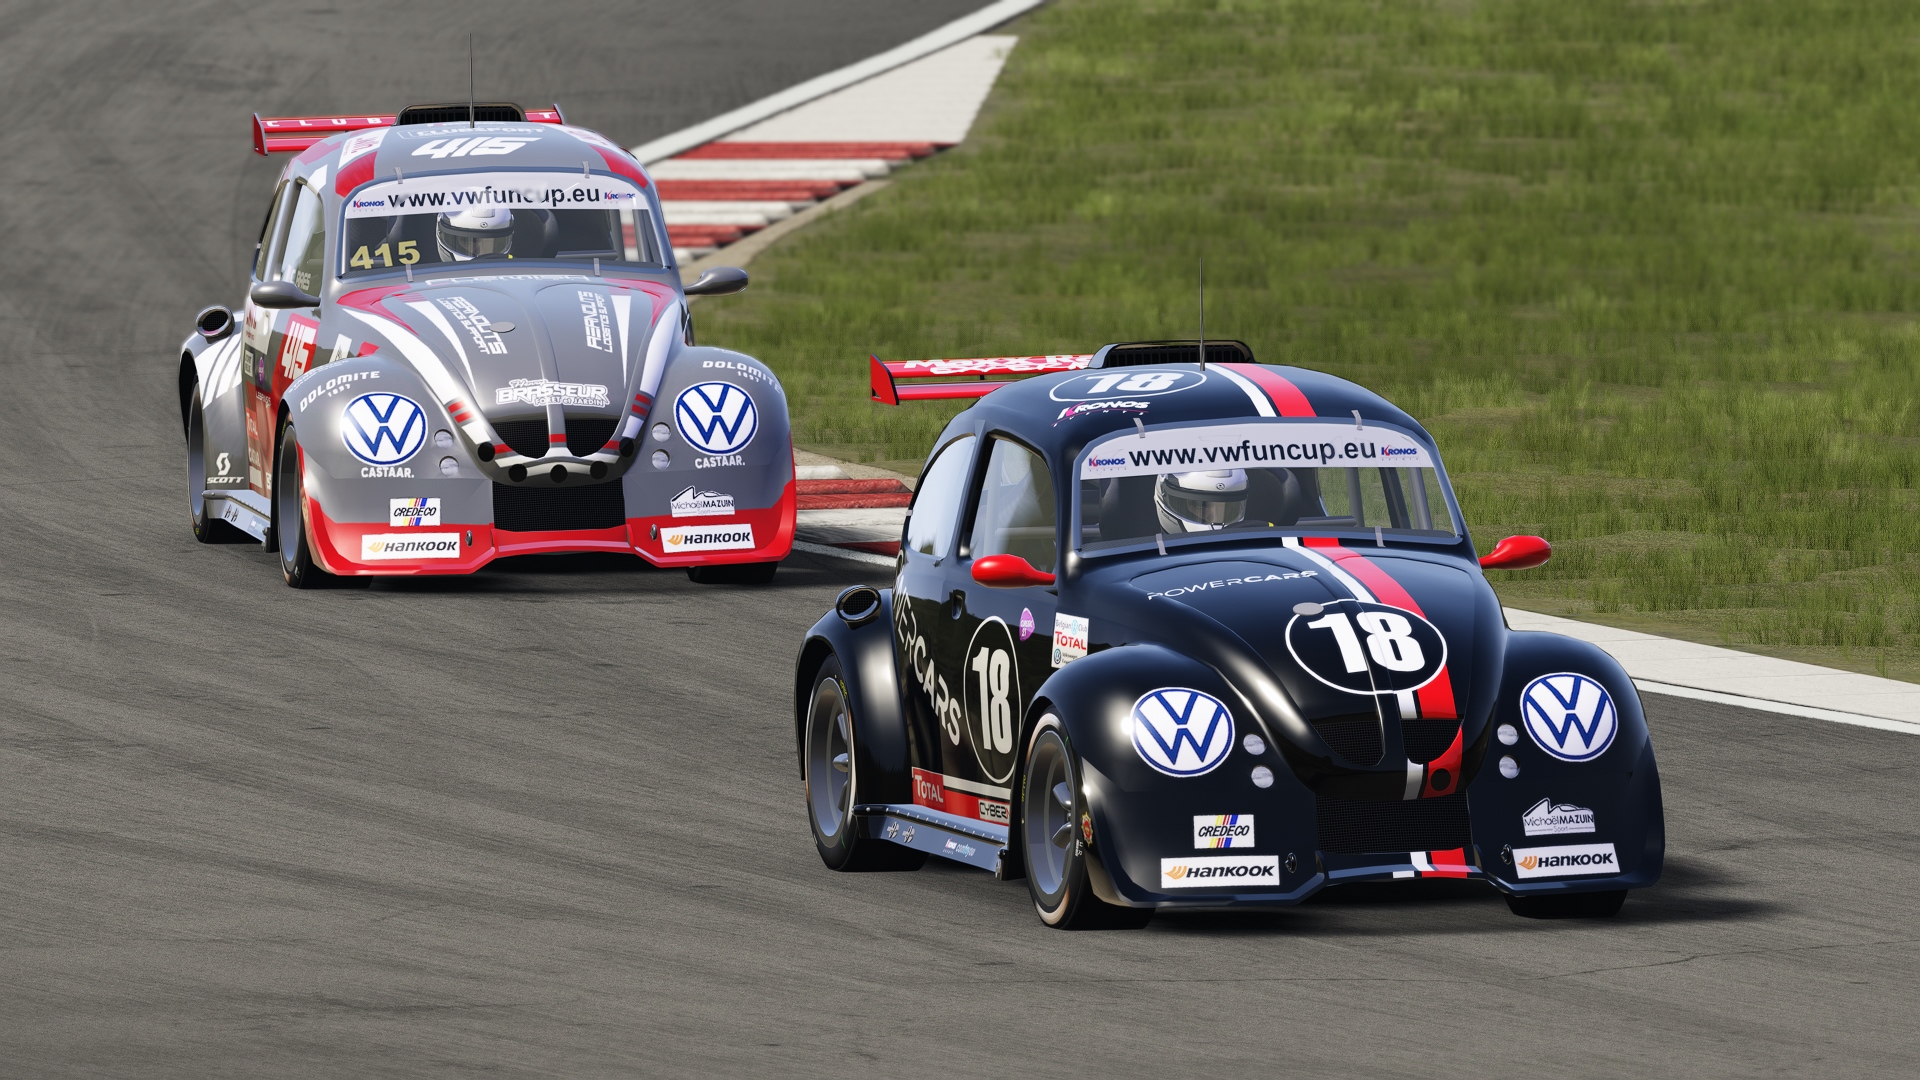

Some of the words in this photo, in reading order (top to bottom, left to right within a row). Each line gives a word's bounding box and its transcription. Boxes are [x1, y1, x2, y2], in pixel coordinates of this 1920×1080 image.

[411, 137, 542, 159] 415
[353, 198, 385, 208] KRONOS
[604, 190, 635, 200] KROOS
[350, 240, 421, 270] 415
[578, 291, 602, 350] AERNOUTS
[599, 317, 613, 353] LOGISTICS
[281, 321, 316, 380] 415
[702, 361, 781, 393] DOLOMITE
[1085, 373, 1185, 394] 18
[300, 371, 381, 413] DOLOMITE
[498, 383, 609, 404] BRASSEUR
[1056, 401, 1150, 420] KRONOS
[1128, 440, 1376, 467] www.vwfuncup.eu
[1381, 444, 1417, 456] KRONOS
[694, 455, 745, 469] CASTAAR.
[1088, 455, 1125, 467] KRONOS
[207, 476, 244, 484] SCOTT
[361, 467, 415, 478] CASTAAR.
[394, 507, 437, 517] CREDECO
[1147, 570, 1318, 600] POWERCARS
[1055, 630, 1086, 650] TOTAL
[1307, 611, 1425, 674] 18
[972, 646, 1013, 754] 18
[914, 774, 944, 803] TOTAL
[1198, 825, 1250, 837] CREDECO
